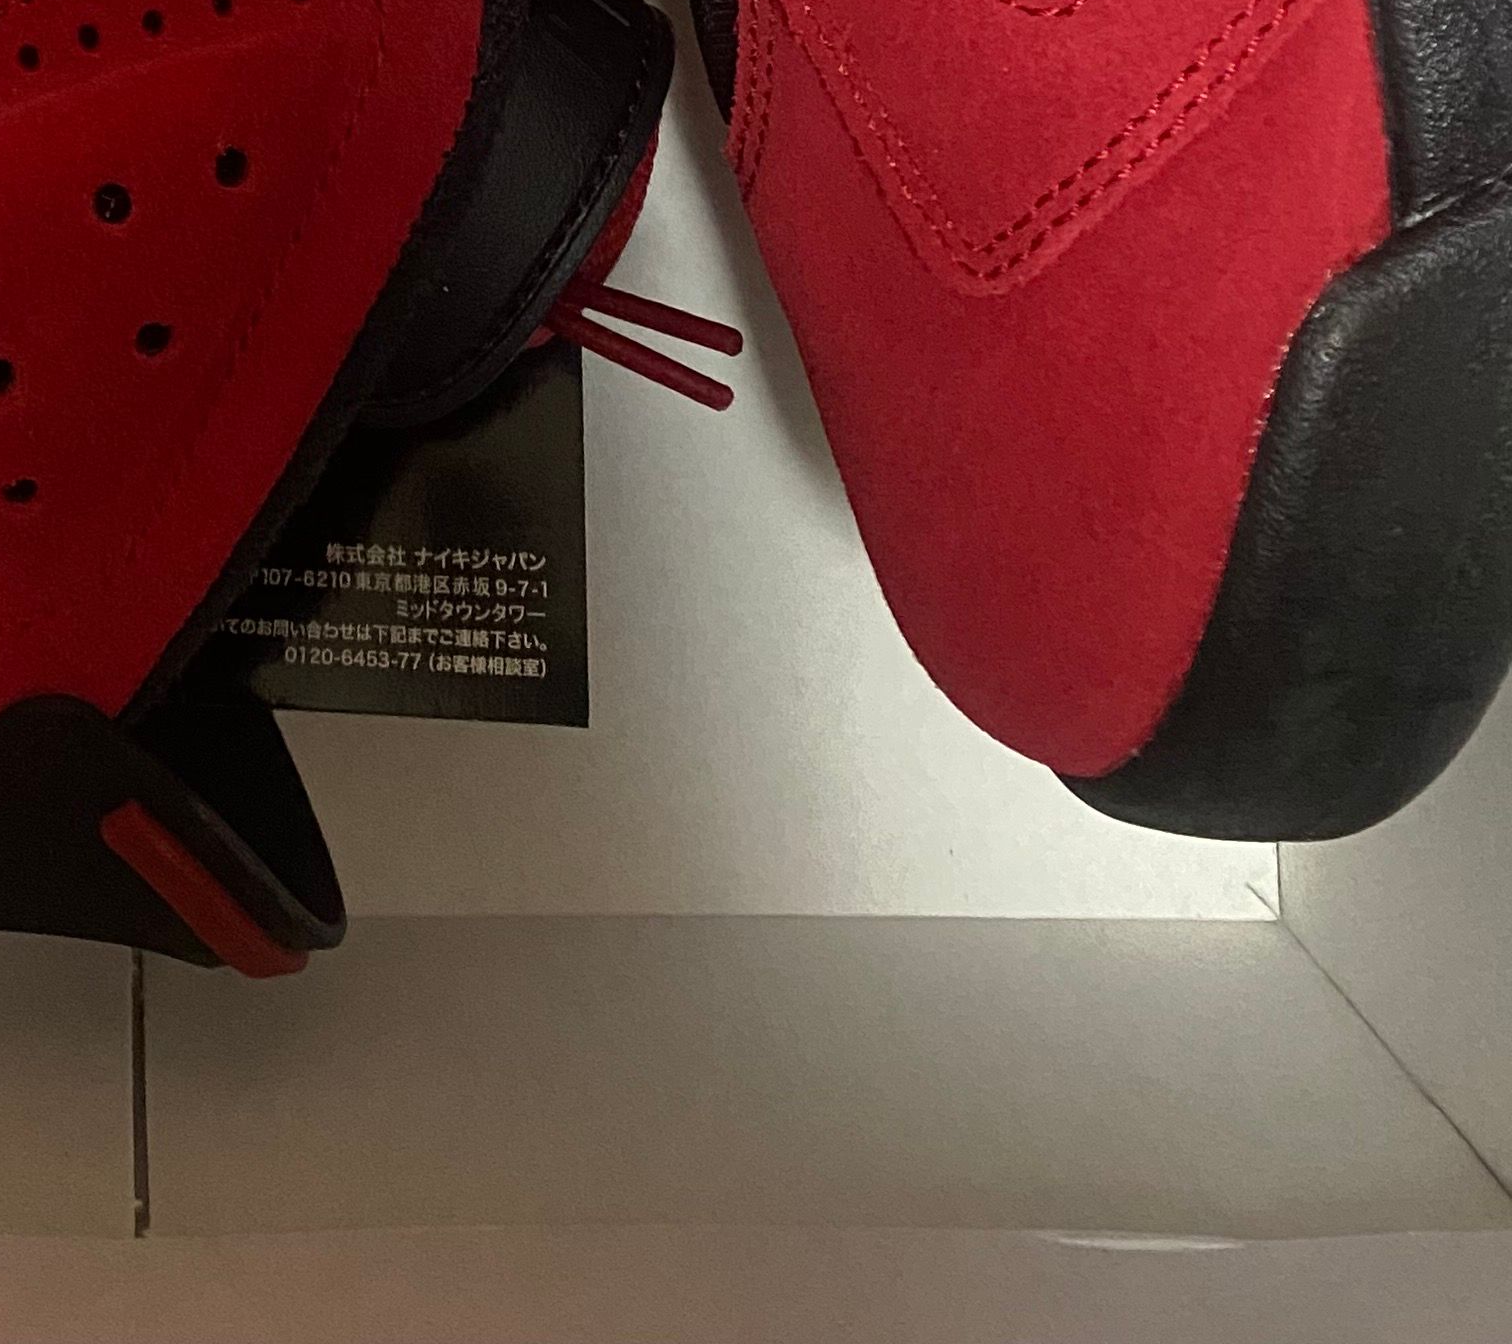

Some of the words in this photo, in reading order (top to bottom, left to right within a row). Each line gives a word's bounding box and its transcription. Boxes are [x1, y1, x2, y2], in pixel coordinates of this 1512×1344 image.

[326, 541, 407, 567] 株式会社
[414, 546, 547, 571] ナイキジャパン
[495, 579, 548, 599] 9-7-1
[396, 599, 546, 624] ミッドタウンタワー
[284, 646, 422, 671] 0120-6453-77
